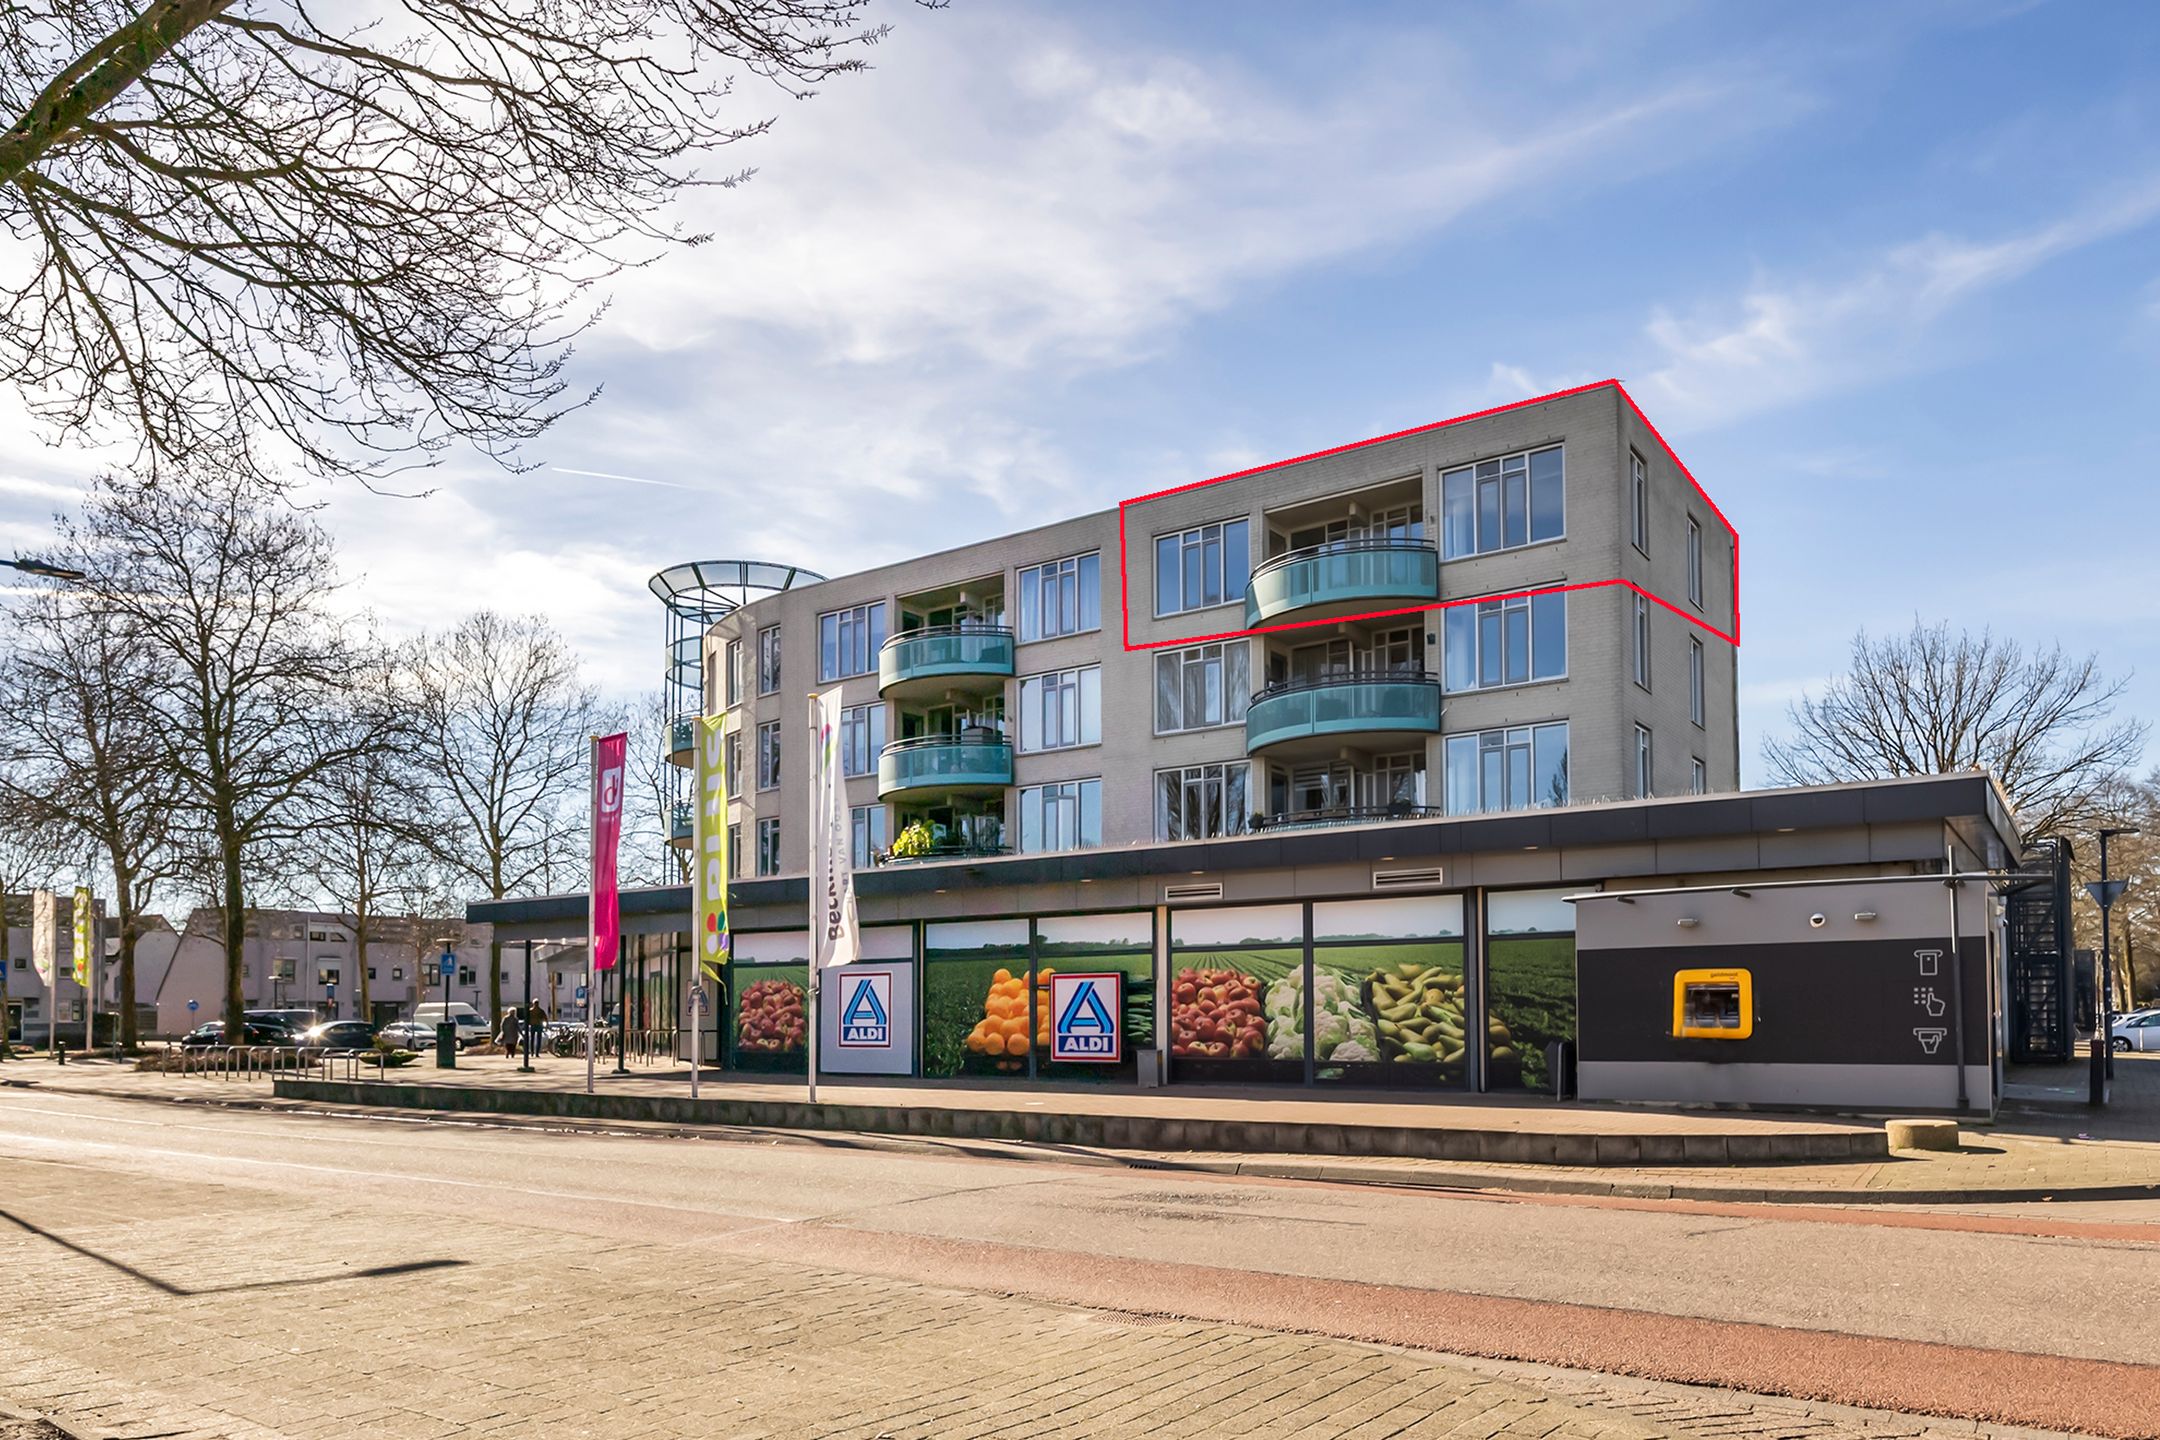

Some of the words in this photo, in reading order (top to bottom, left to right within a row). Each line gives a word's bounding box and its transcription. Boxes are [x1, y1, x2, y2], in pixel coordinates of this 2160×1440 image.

[835, 838, 847, 864] VAN
[847, 1027, 883, 1041] ALDI
[1064, 1037, 1109, 1051] ALDI
